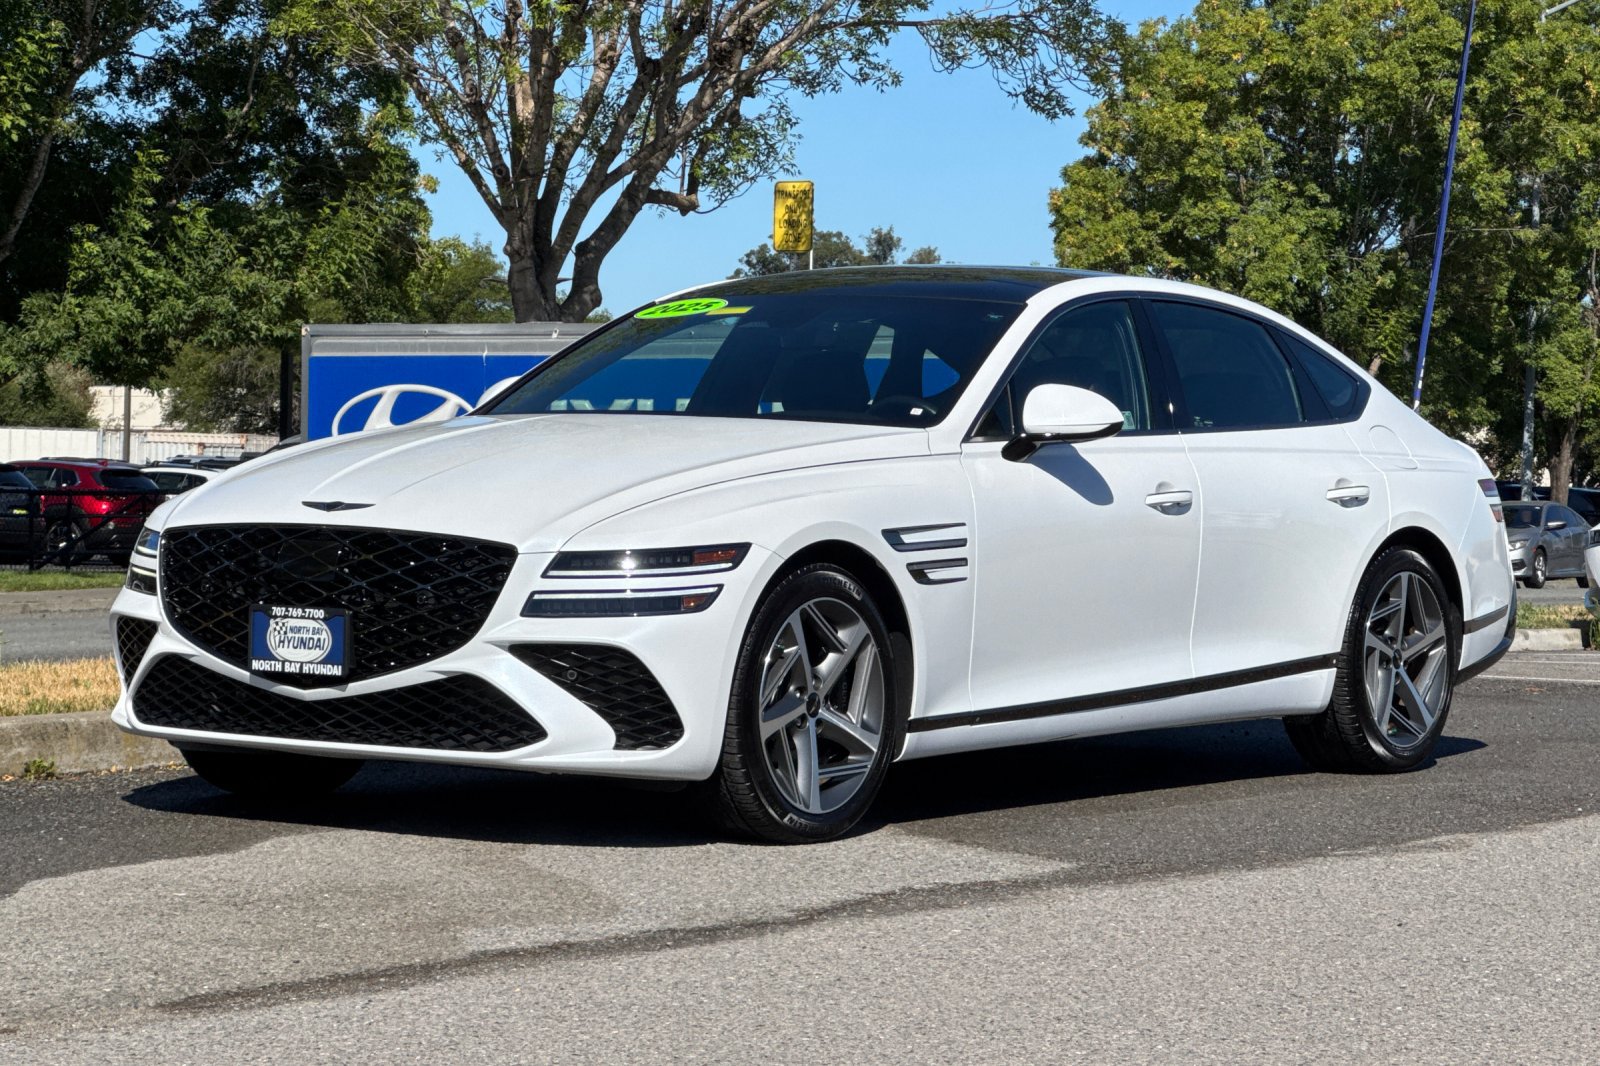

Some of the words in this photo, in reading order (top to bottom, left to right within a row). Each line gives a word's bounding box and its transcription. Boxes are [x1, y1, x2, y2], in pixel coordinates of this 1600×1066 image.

[777, 189, 810, 200] TRANSPORT
[785, 204, 801, 213] ONLY
[779, 218, 807, 229] LOADING
[784, 233, 801, 243] ZONE
[642, 302, 721, 316] 2025
[821, 576, 861, 597] MICHELIN
[272, 606, 325, 618] 707-769-7700
[288, 625, 310, 636] NORTH
[311, 626, 324, 636] BAY
[278, 636, 326, 650] HYUNDAI
[252, 659, 282, 672] NORTH
[284, 661, 301, 673] BAY
[302, 663, 342, 676] HYUNDAI
